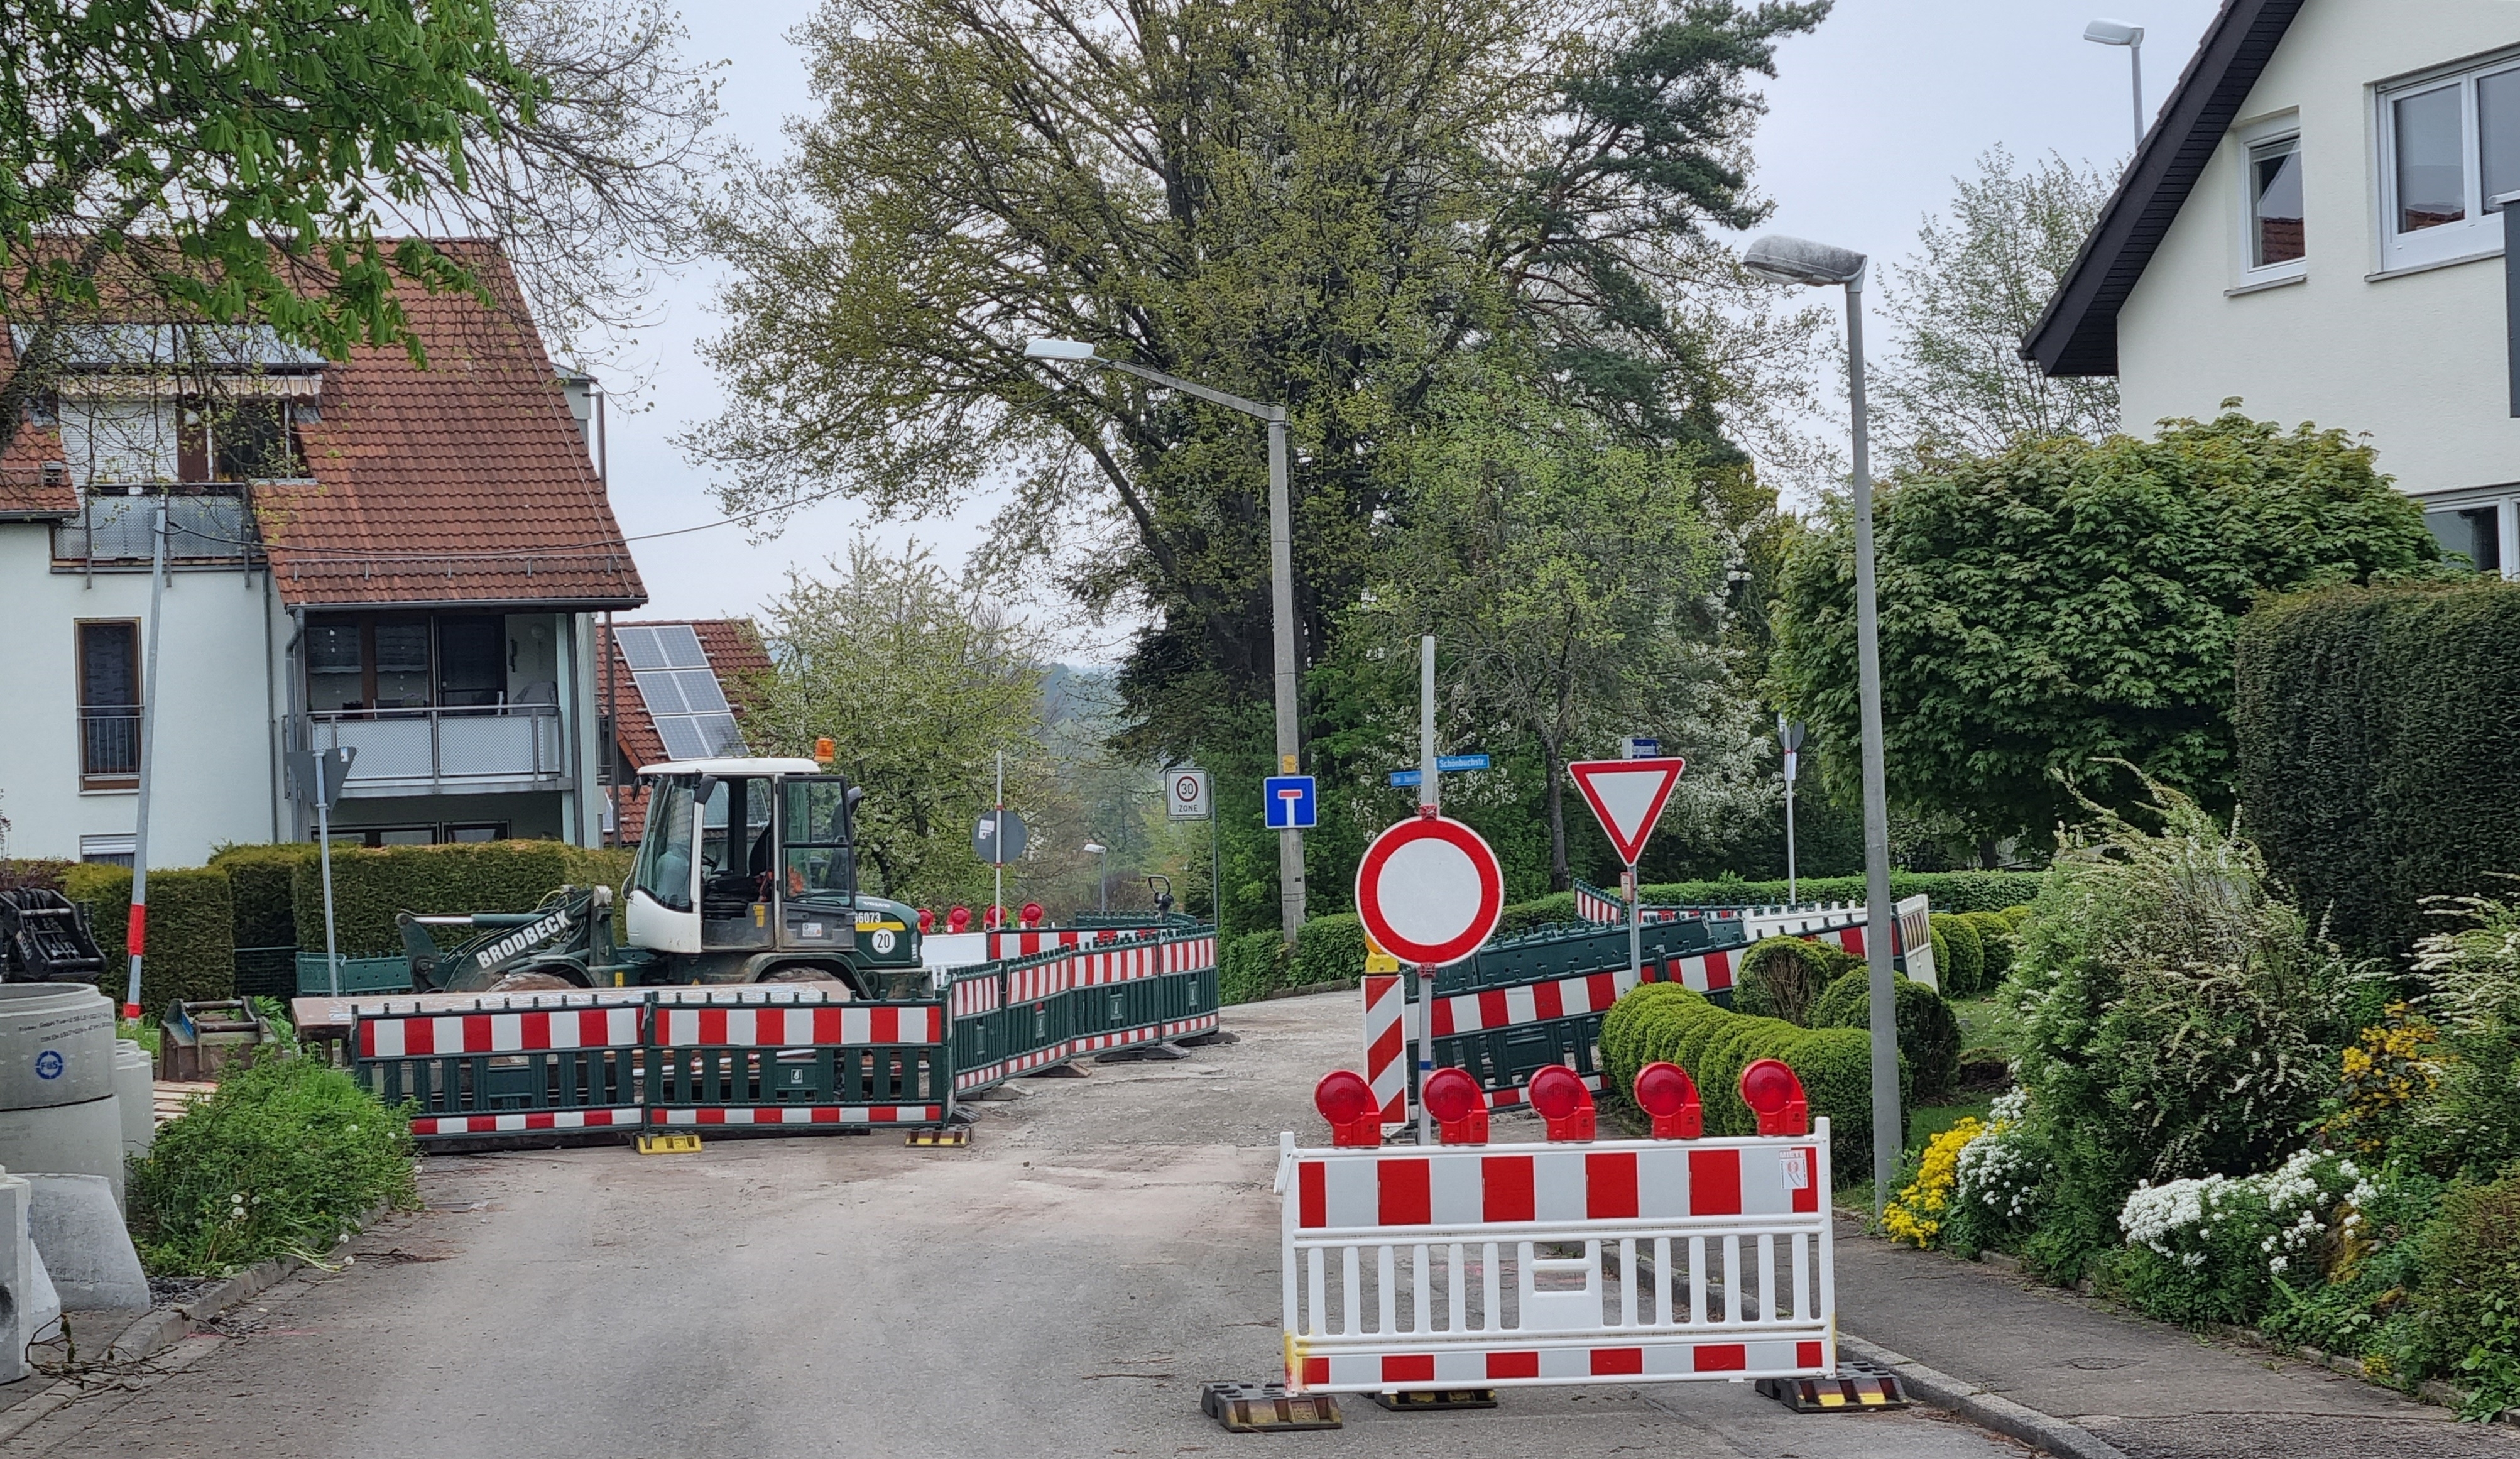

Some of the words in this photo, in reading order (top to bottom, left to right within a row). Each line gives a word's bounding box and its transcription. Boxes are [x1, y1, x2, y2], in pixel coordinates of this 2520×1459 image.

[1439, 758, 1486, 768] Schönbuchstr.
[1181, 783, 1194, 795] 30
[1178, 804, 1198, 812] ZONE
[476, 909, 572, 970] BRODBECK
[877, 934, 890, 948] 20
